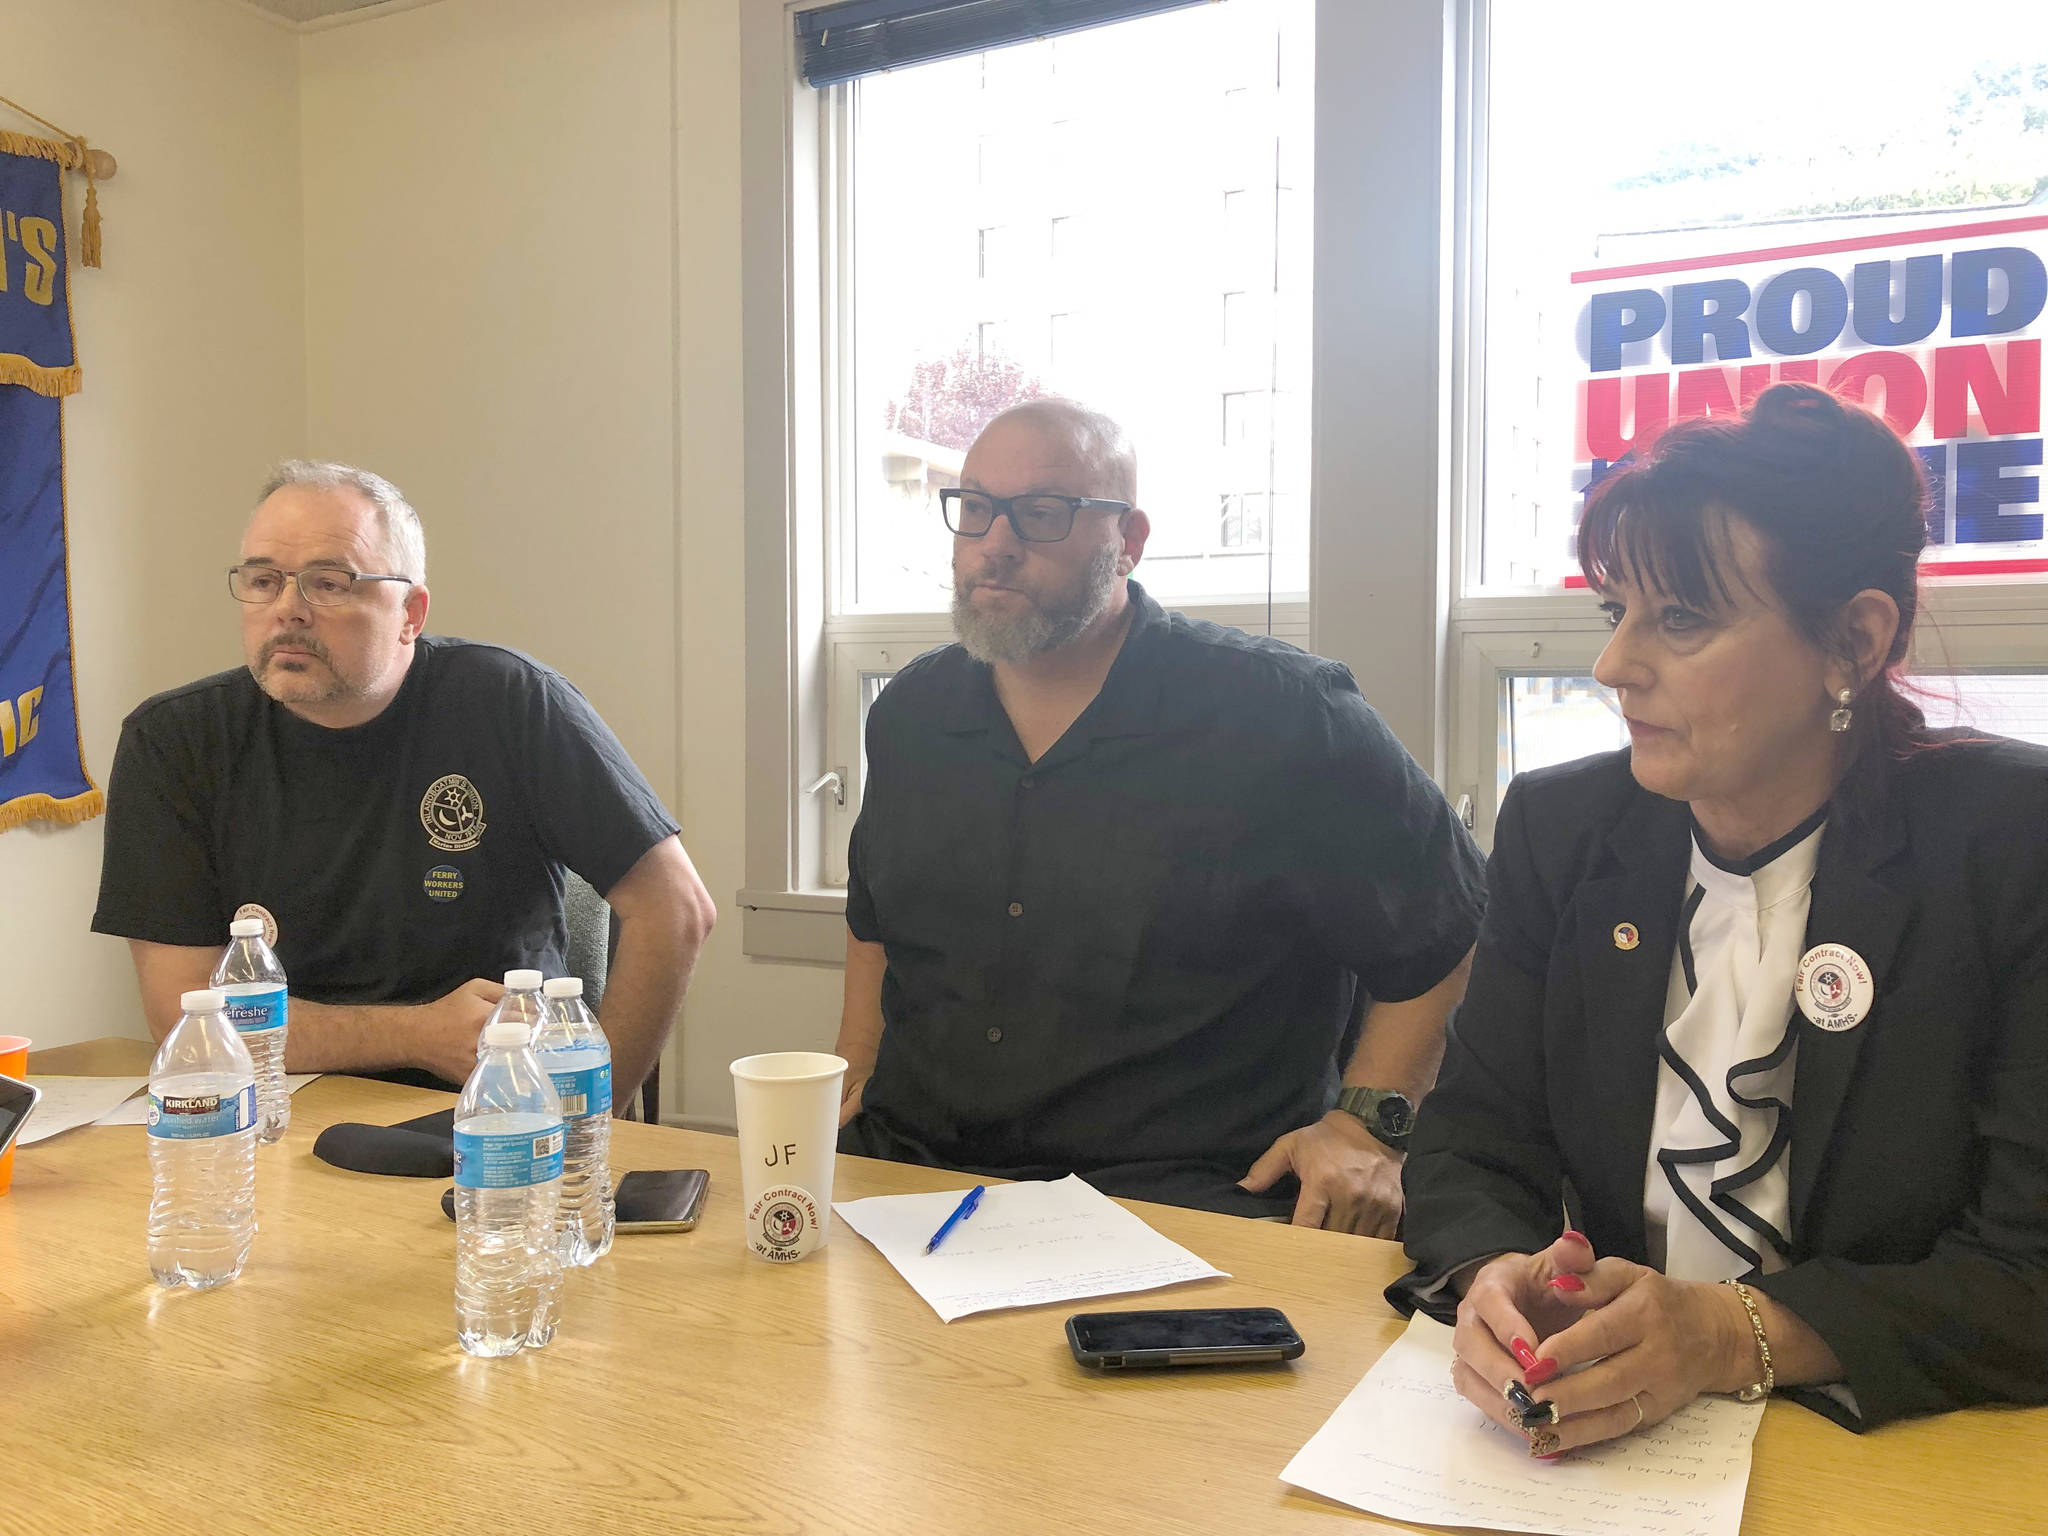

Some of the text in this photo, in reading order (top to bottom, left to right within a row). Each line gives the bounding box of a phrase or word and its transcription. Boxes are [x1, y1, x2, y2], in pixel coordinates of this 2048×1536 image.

[1590, 247, 2047, 372] PROUD
[1587, 339, 2041, 462] UNON
[432, 871, 458, 880] FERRY
[424, 880, 464, 889] WORKERS
[428, 889, 457, 898] UNITED
[1796, 970, 1805, 993] Fair
[1802, 948, 1845, 969] Contract
[1846, 955, 1868, 985] Now!
[224, 1005, 268, 1019] efreshe
[1827, 1012, 1858, 1030] AMHS-
[166, 1097, 218, 1109] KIRKLAND
[748, 1200, 764, 1221] Fair
[763, 1188, 808, 1204] Contract
[805, 1202, 819, 1230] Now!
[767, 1247, 801, 1262] AMHS-
